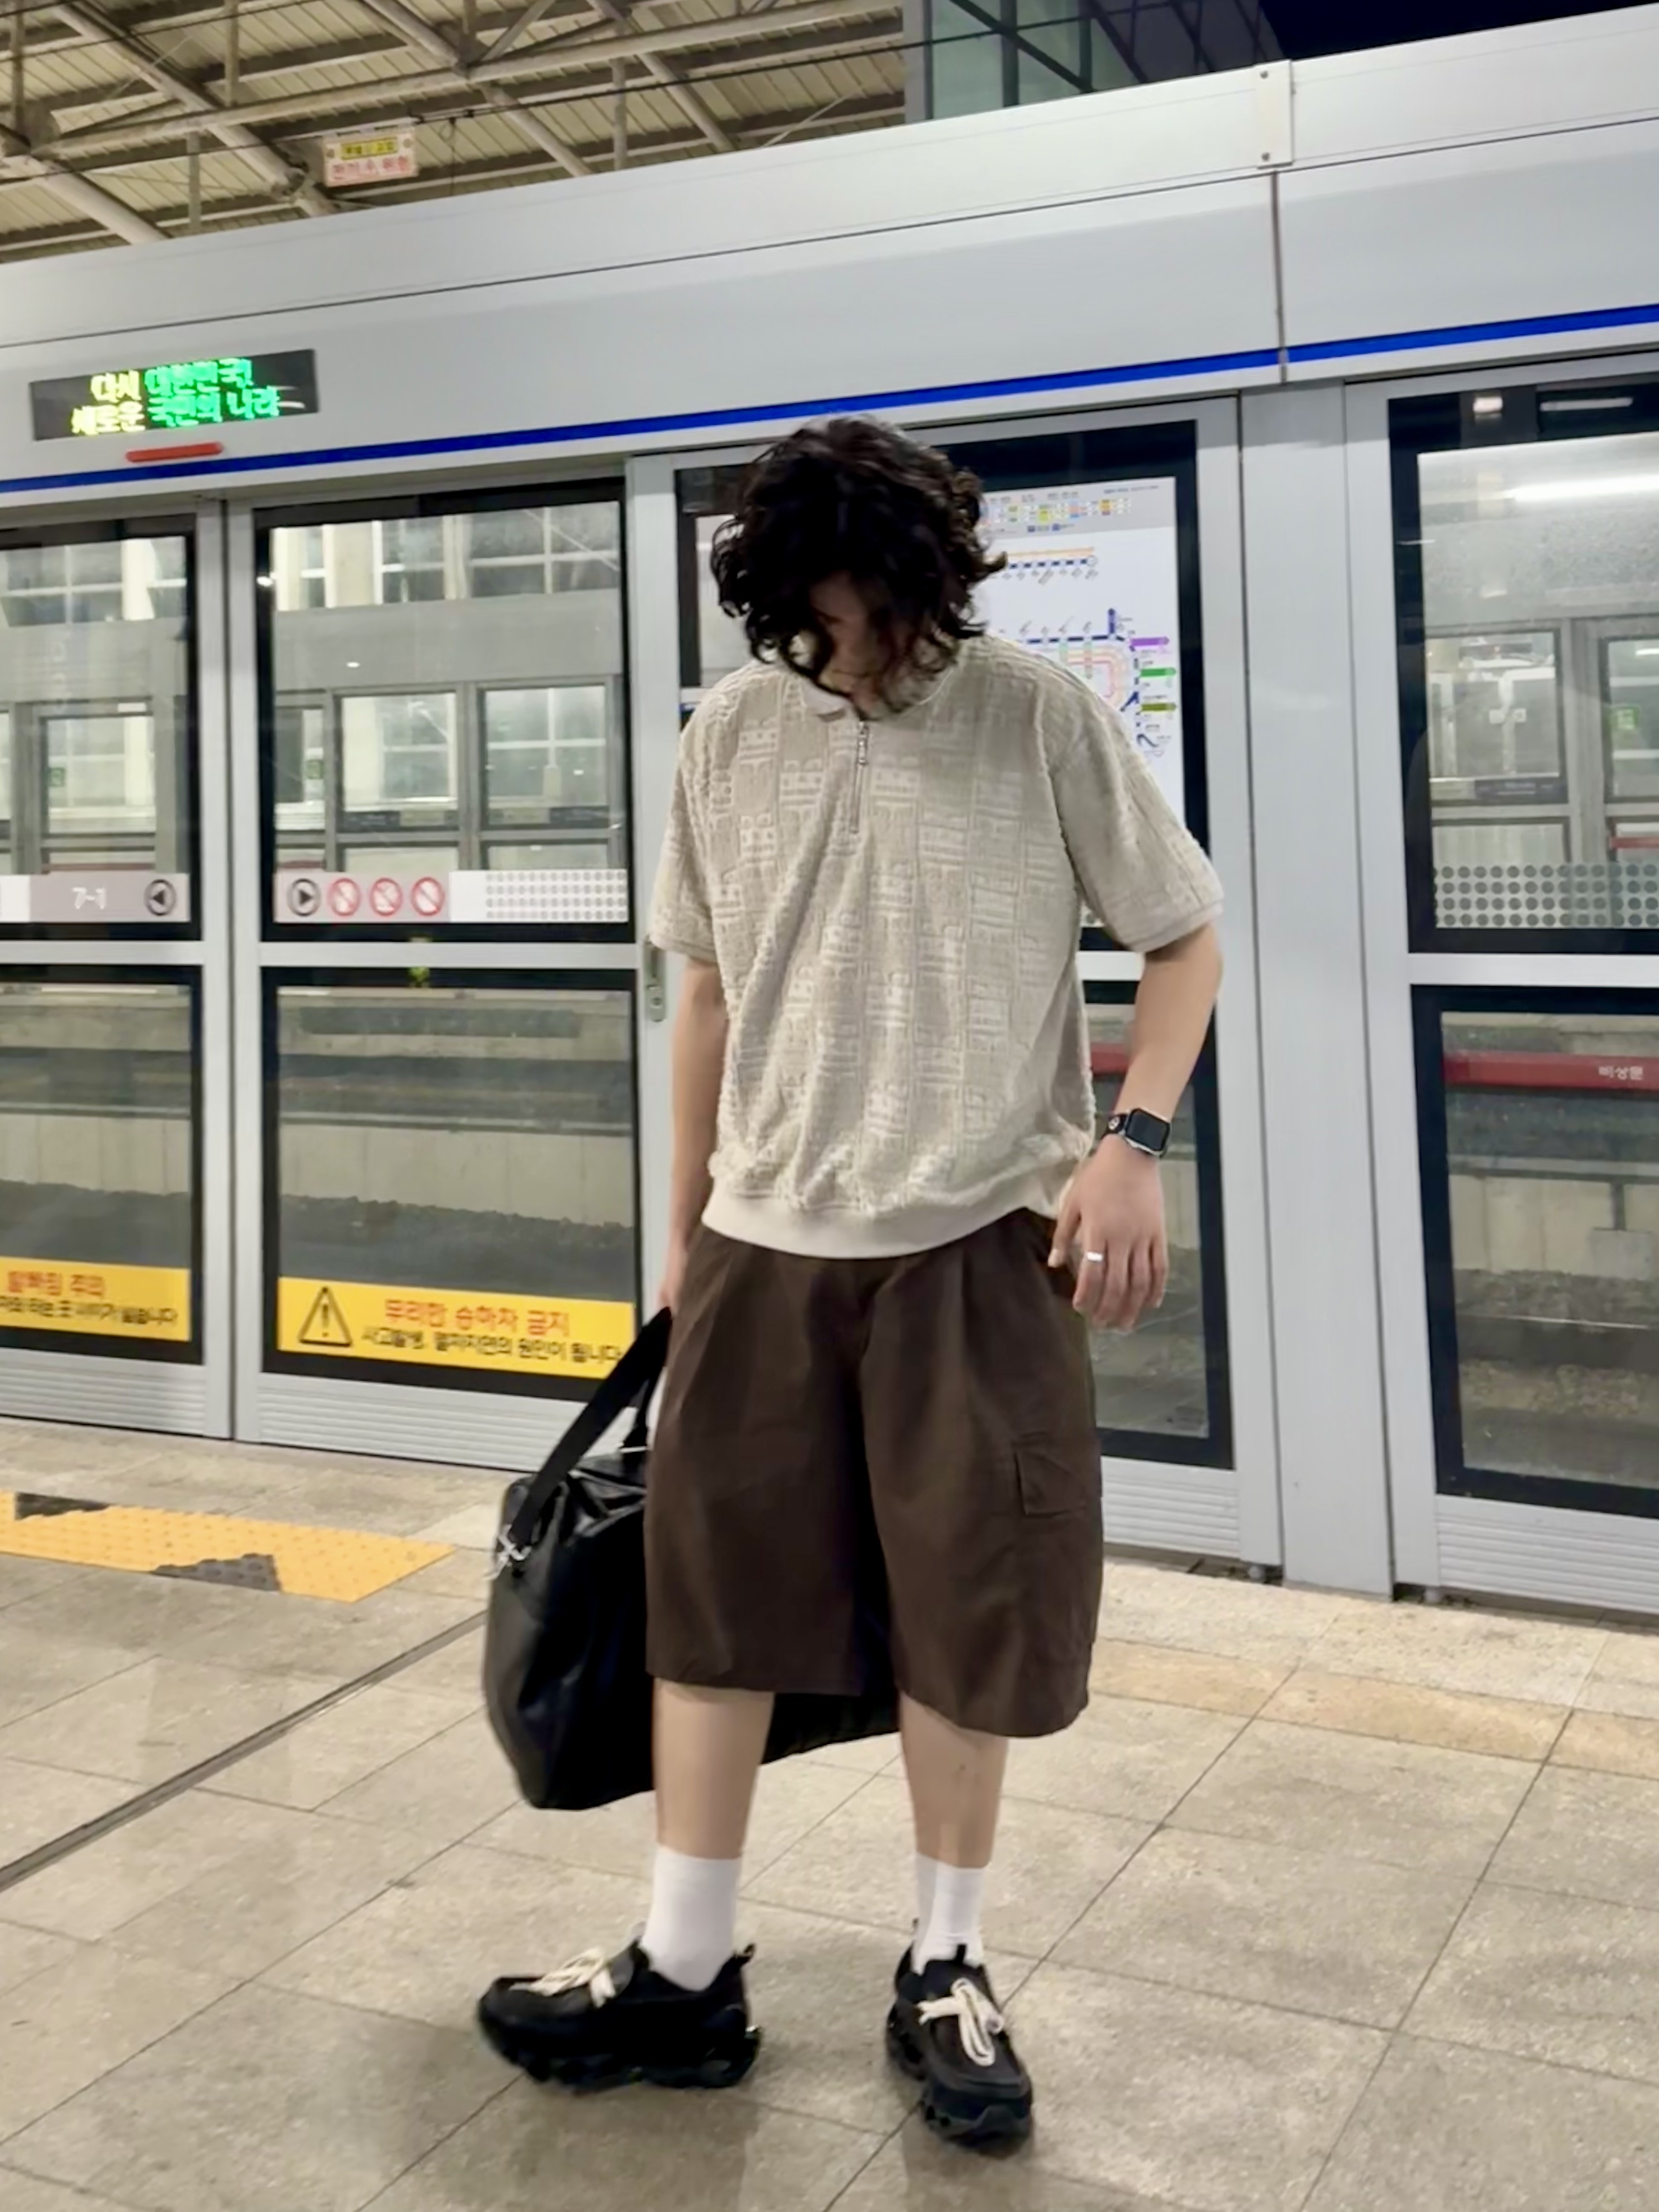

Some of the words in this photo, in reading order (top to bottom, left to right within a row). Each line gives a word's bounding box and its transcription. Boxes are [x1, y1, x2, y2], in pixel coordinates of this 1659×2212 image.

[72, 887, 107, 910] 7-1
[385, 1299, 448, 1329] 무리한
[456, 1306, 518, 1333] 승하차
[527, 1310, 569, 1337] 금지
